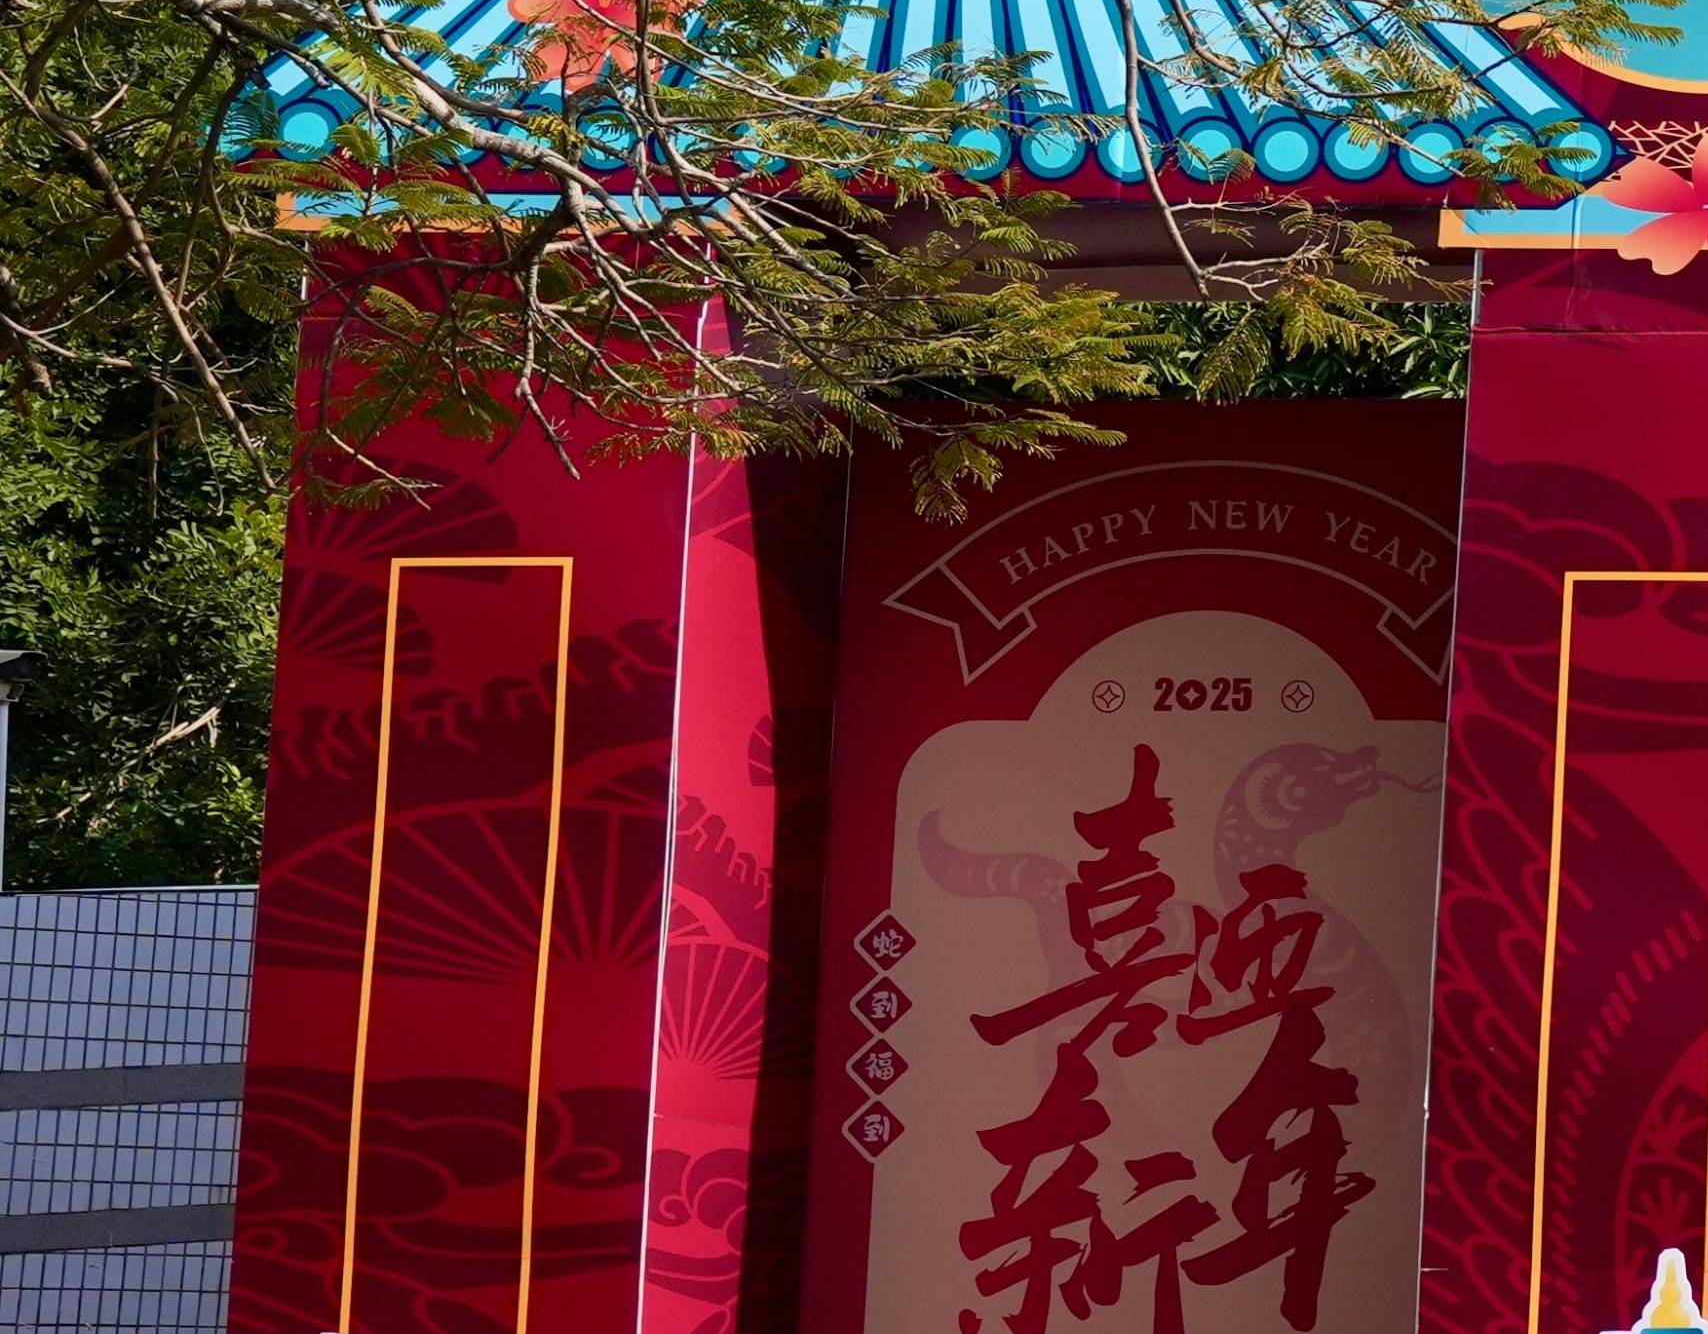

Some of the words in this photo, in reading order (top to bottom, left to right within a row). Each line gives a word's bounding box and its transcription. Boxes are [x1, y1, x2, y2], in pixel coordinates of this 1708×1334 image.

[999, 503, 1159, 585] HAPPY
[1188, 499, 1296, 535] NEW
[1323, 511, 1440, 586] YEAR
[1153, 677, 1253, 712] 2025
[863, 928, 905, 1144] 蛇到福到
